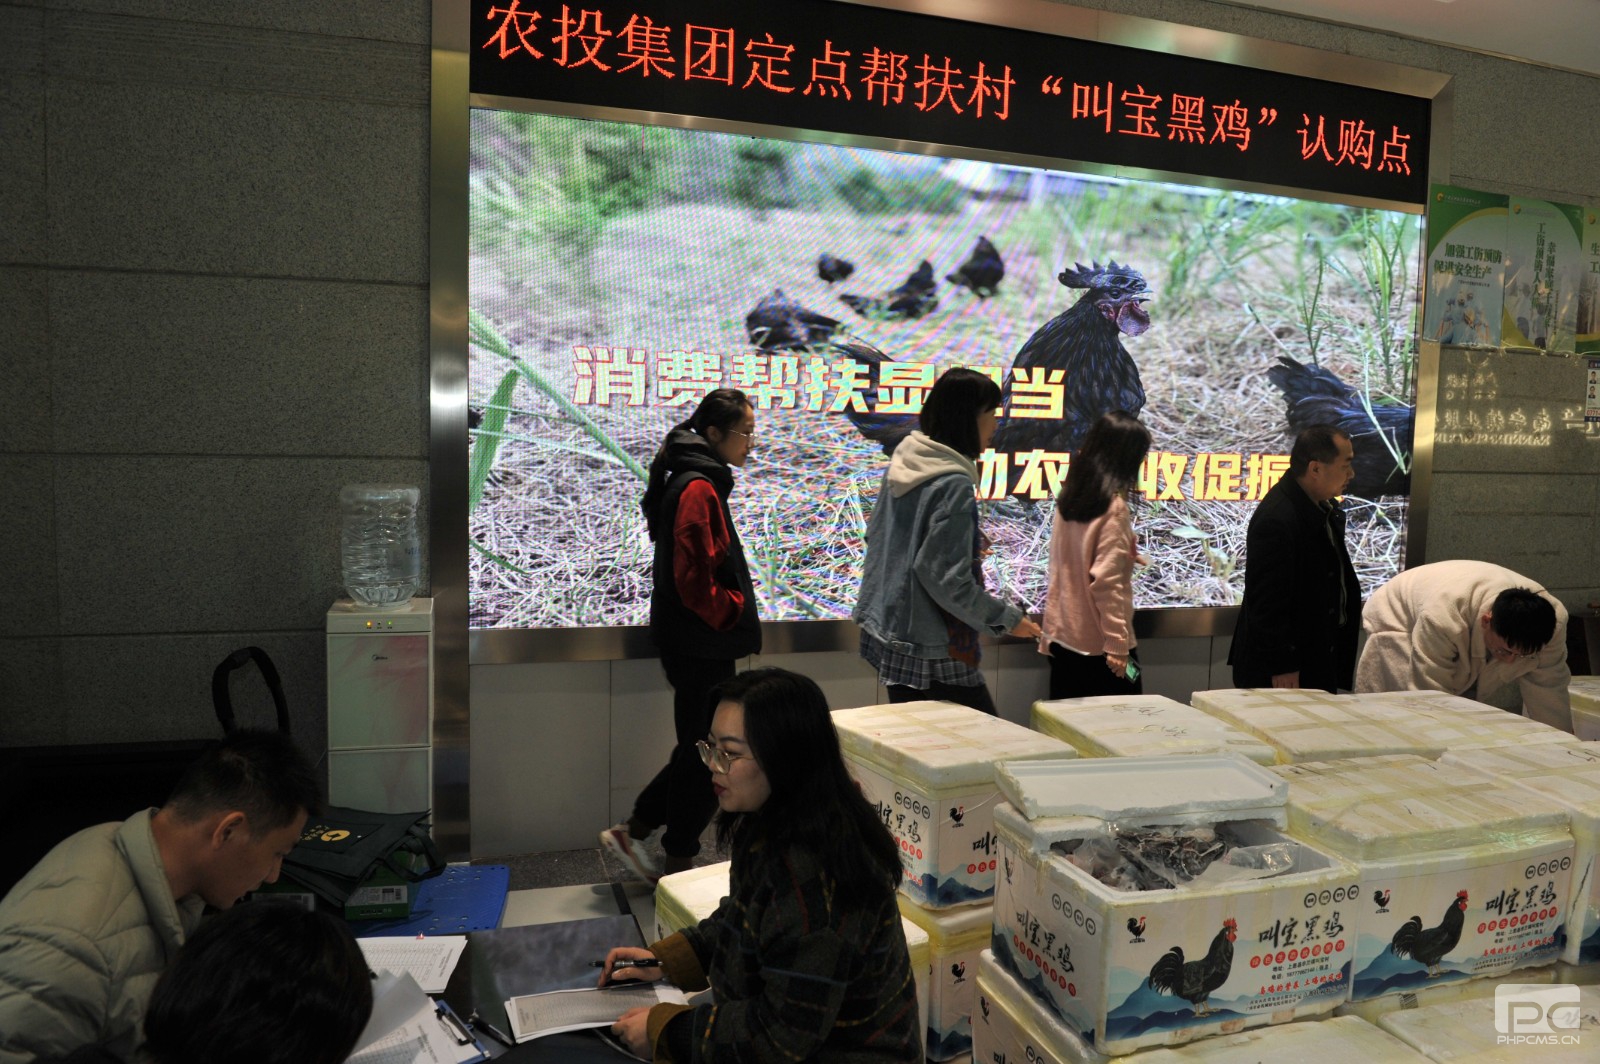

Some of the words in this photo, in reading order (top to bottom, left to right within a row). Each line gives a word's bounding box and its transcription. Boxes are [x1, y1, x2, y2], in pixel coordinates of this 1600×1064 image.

[1433, 260, 1492, 281] 促进安全生产
[1445, 242, 1503, 264] 加强工伤预防
[572, 345, 1066, 420] 消费帮扶显当
[1485, 880, 1558, 916] 叫宝黑鸡
[1016, 908, 1075, 973] 叫宝黑鸡
[1258, 910, 1345, 949] 叫宝黑鸡
